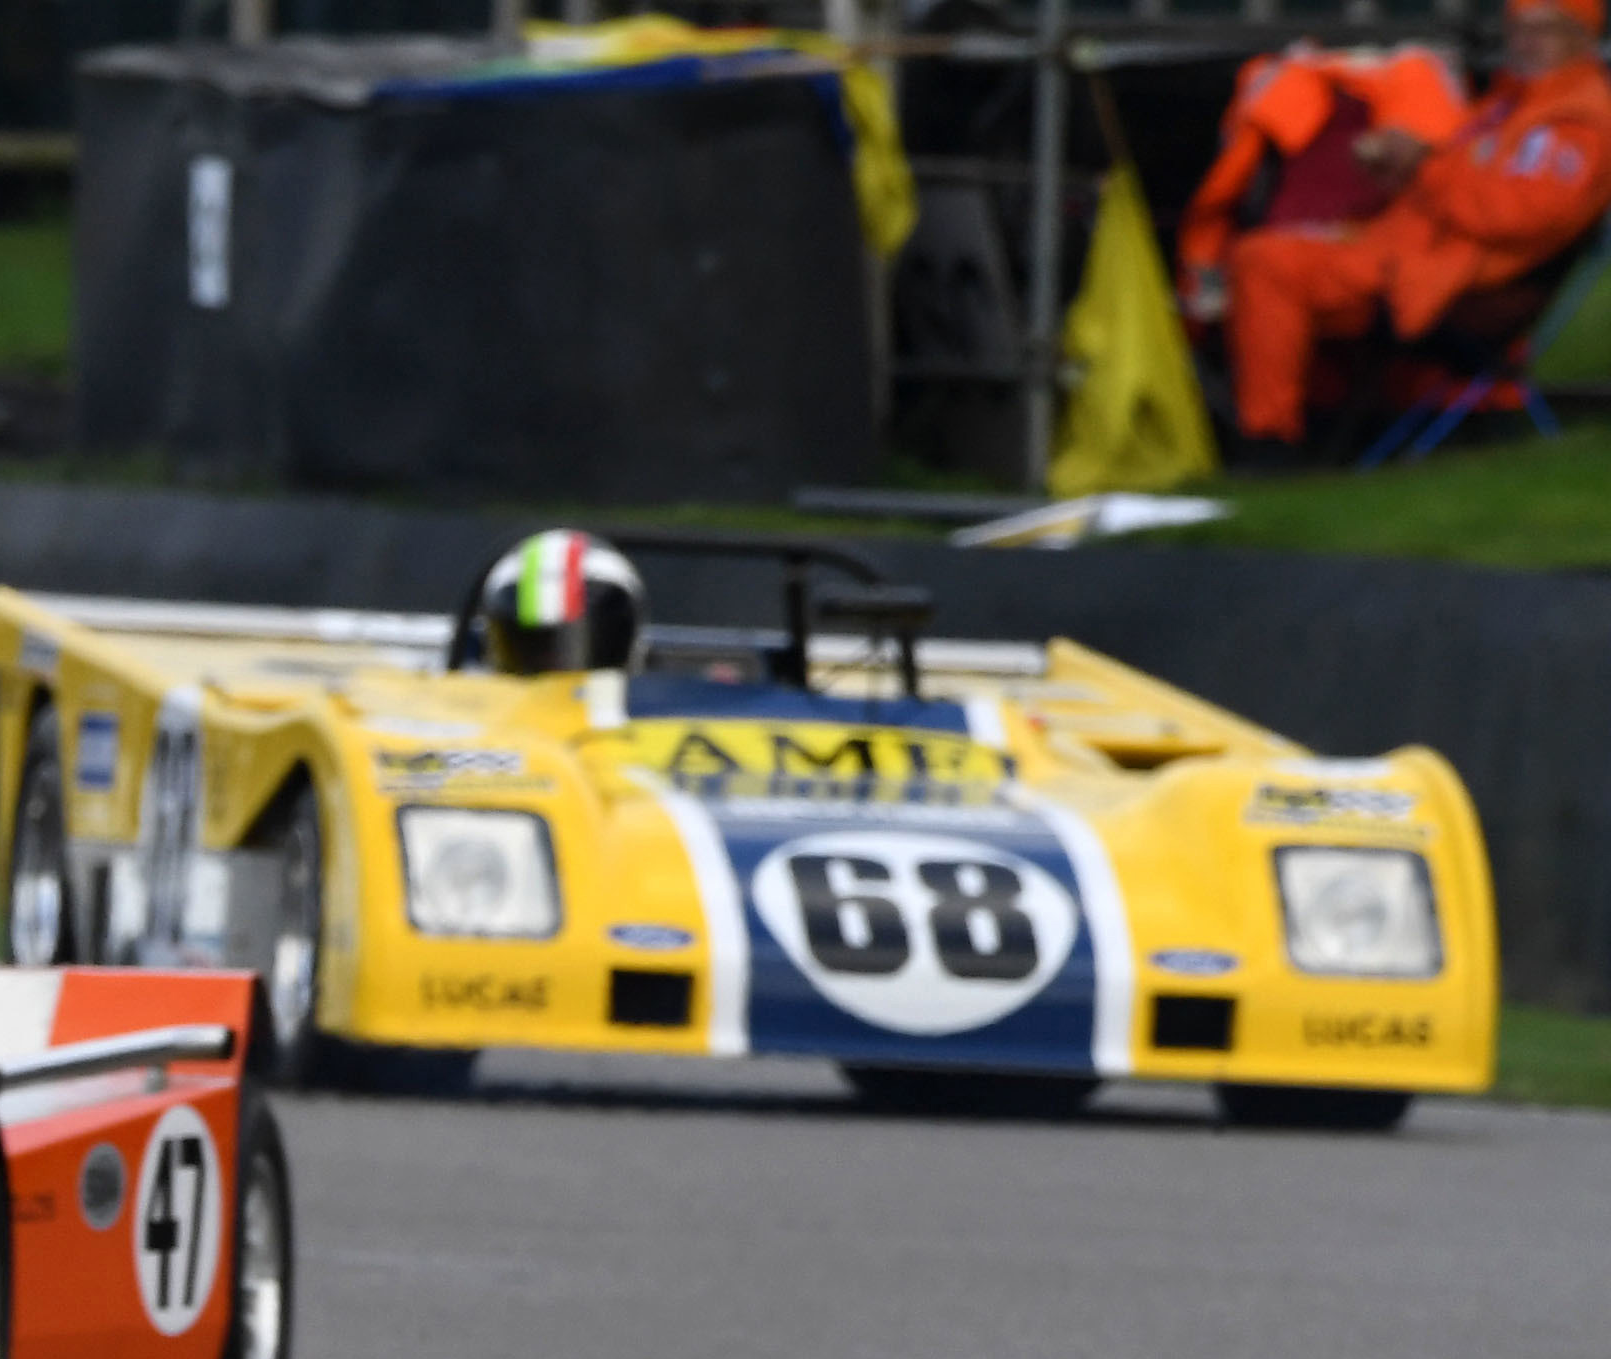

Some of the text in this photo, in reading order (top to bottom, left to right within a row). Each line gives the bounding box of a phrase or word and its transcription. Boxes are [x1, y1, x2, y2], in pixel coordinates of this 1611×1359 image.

[789, 855, 1037, 979] 68
[1303, 1012, 1435, 1049] LUCAS
[147, 1136, 206, 1308] 47
